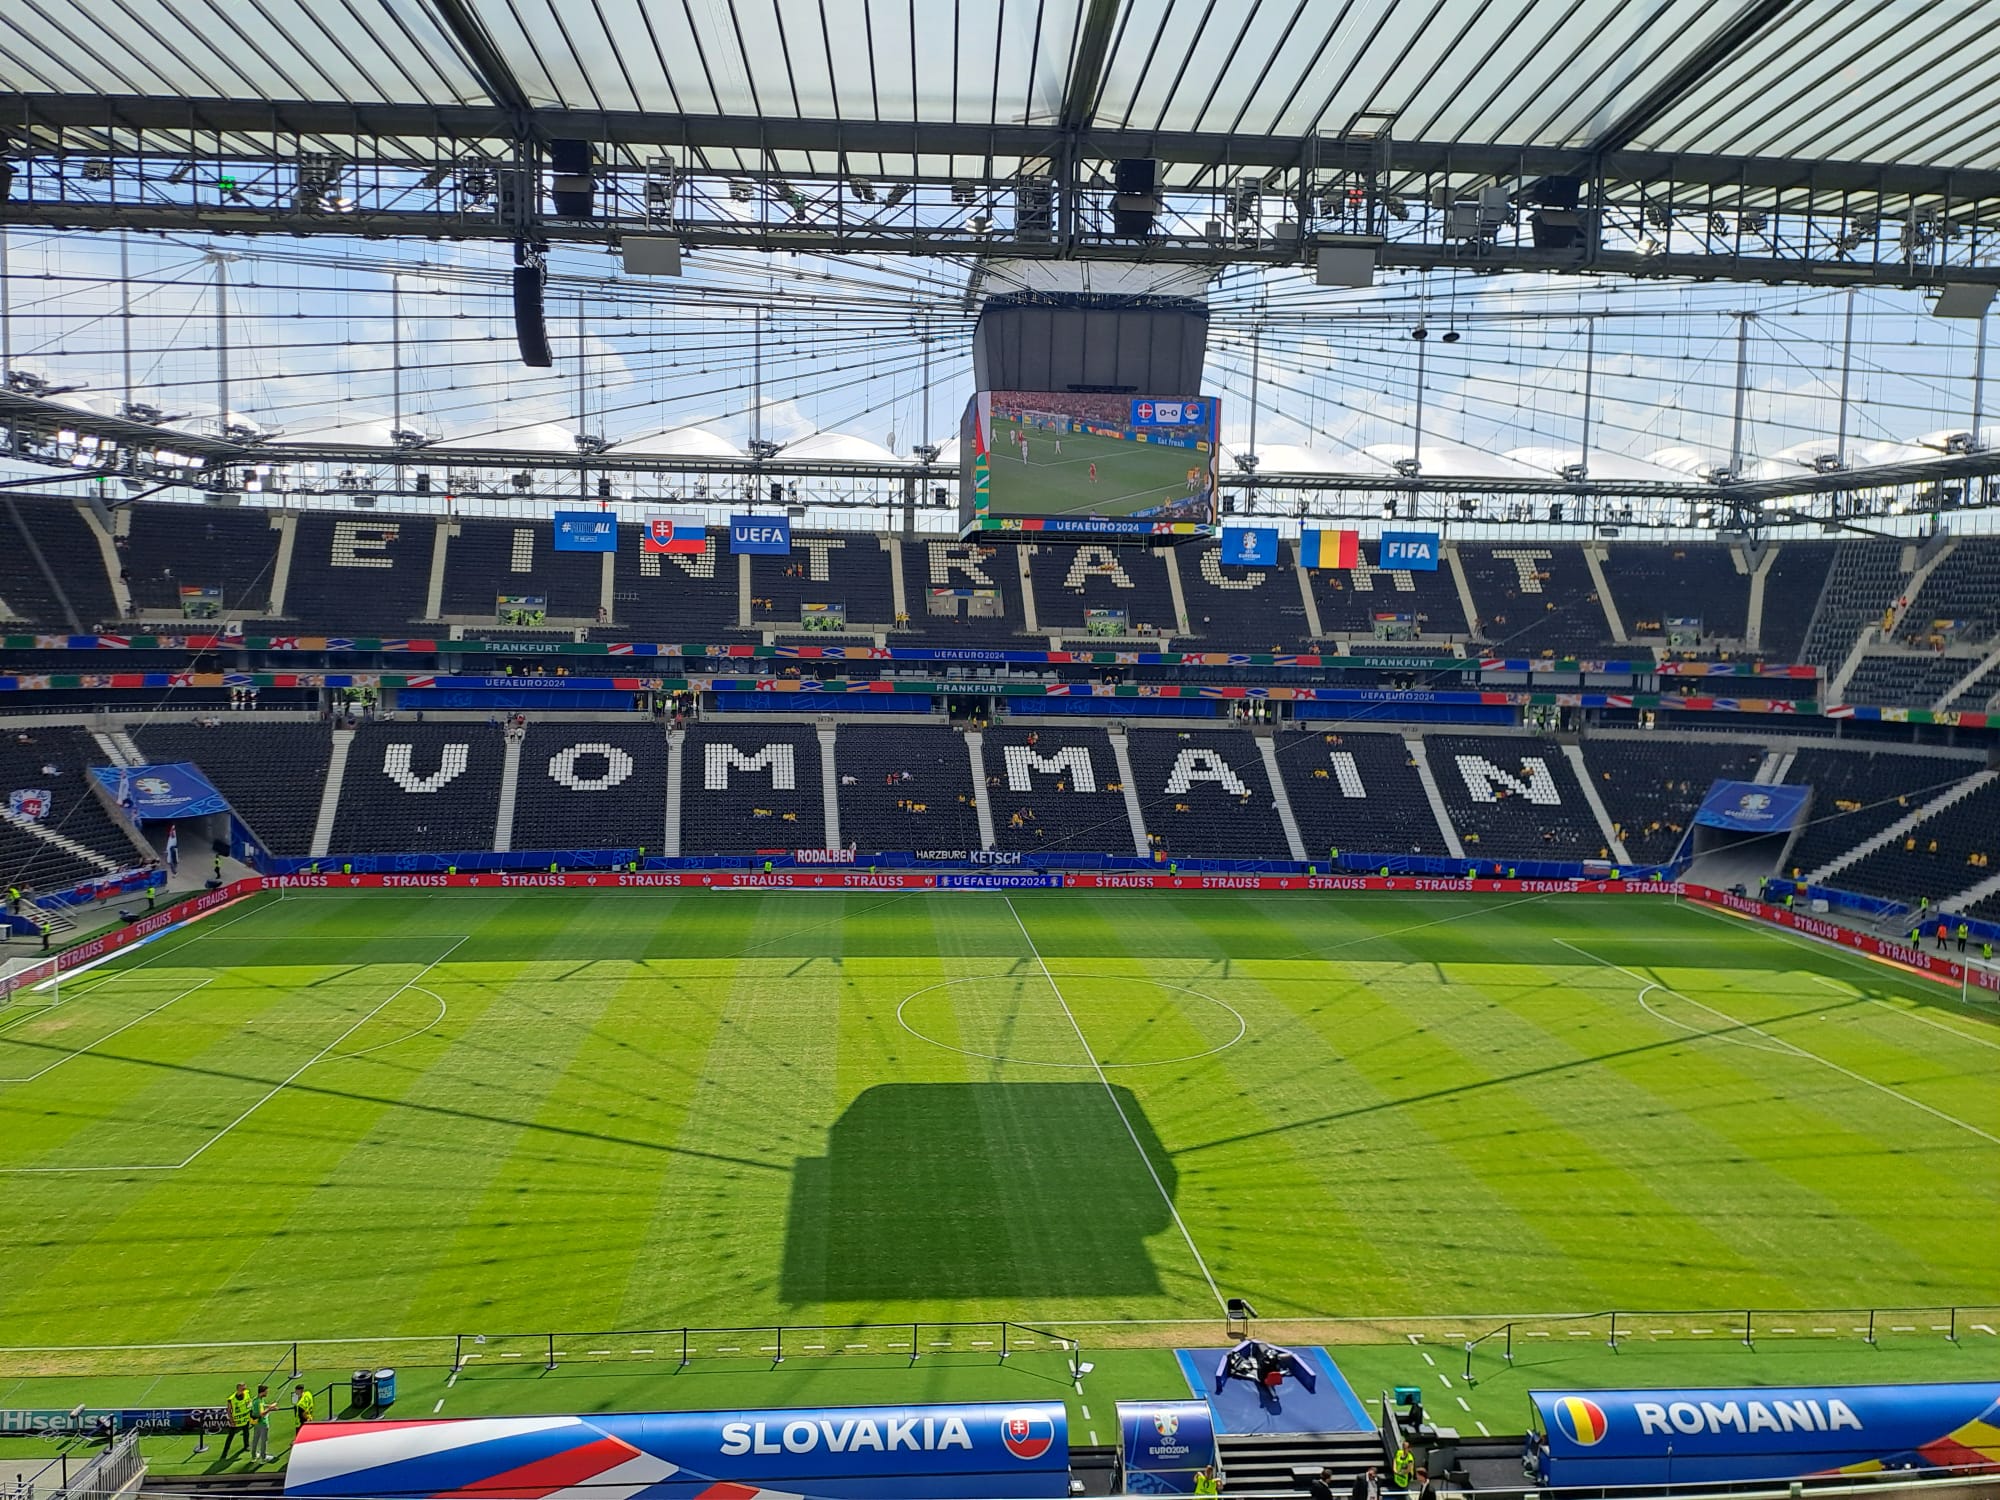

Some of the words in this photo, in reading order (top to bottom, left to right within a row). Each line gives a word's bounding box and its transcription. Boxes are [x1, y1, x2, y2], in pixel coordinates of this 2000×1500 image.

[735, 527, 784, 543] UEFA
[1388, 542, 1430, 559] FIFA
[485, 643, 561, 652] FRANKFURT
[1364, 658, 1435, 667] FRANKFURT
[936, 684, 1004, 692] FRANKFURT
[383, 743, 795, 793] VOM
[1003, 746, 1561, 806] MAIN
[797, 849, 855, 863] RODALBEN
[916, 850, 967, 860] HARZBURG
[970, 851, 1021, 864] KETSCH
[261, 875, 328, 889] STRAUSS
[382, 875, 448, 886] STRAUSS
[501, 875, 566, 887] STRAUSS
[618, 875, 681, 886] STRAUSS
[732, 875, 794, 886] STRAUSS
[843, 876, 904, 886] STRAUSS
[1095, 877, 1154, 887] STRAUSS
[1202, 877, 1260, 888] STRAUSS
[1308, 878, 1367, 889] STRAUSS
[1415, 879, 1473, 890] STRAUSS
[1521, 881, 1578, 892] STRAUSS
[1625, 882, 1686, 894] STRAUSS
[197, 887, 229, 910] STRAUSS
[1722, 894, 1761, 916] STRAUSS
[136, 912, 172, 937] STRAUSS
[1793, 915, 1839, 940] STRAUSS
[59, 940, 104, 969] STRAUSS
[1878, 941, 1931, 968] STRAUSS
[190, 1409, 231, 1421] QATA
[1634, 1399, 1863, 1436] ROMANIA
[136, 1419, 171, 1428] QATAR
[720, 1417, 974, 1456] SLOVAKIA
[1149, 1446, 1189, 1455] EURO2024
